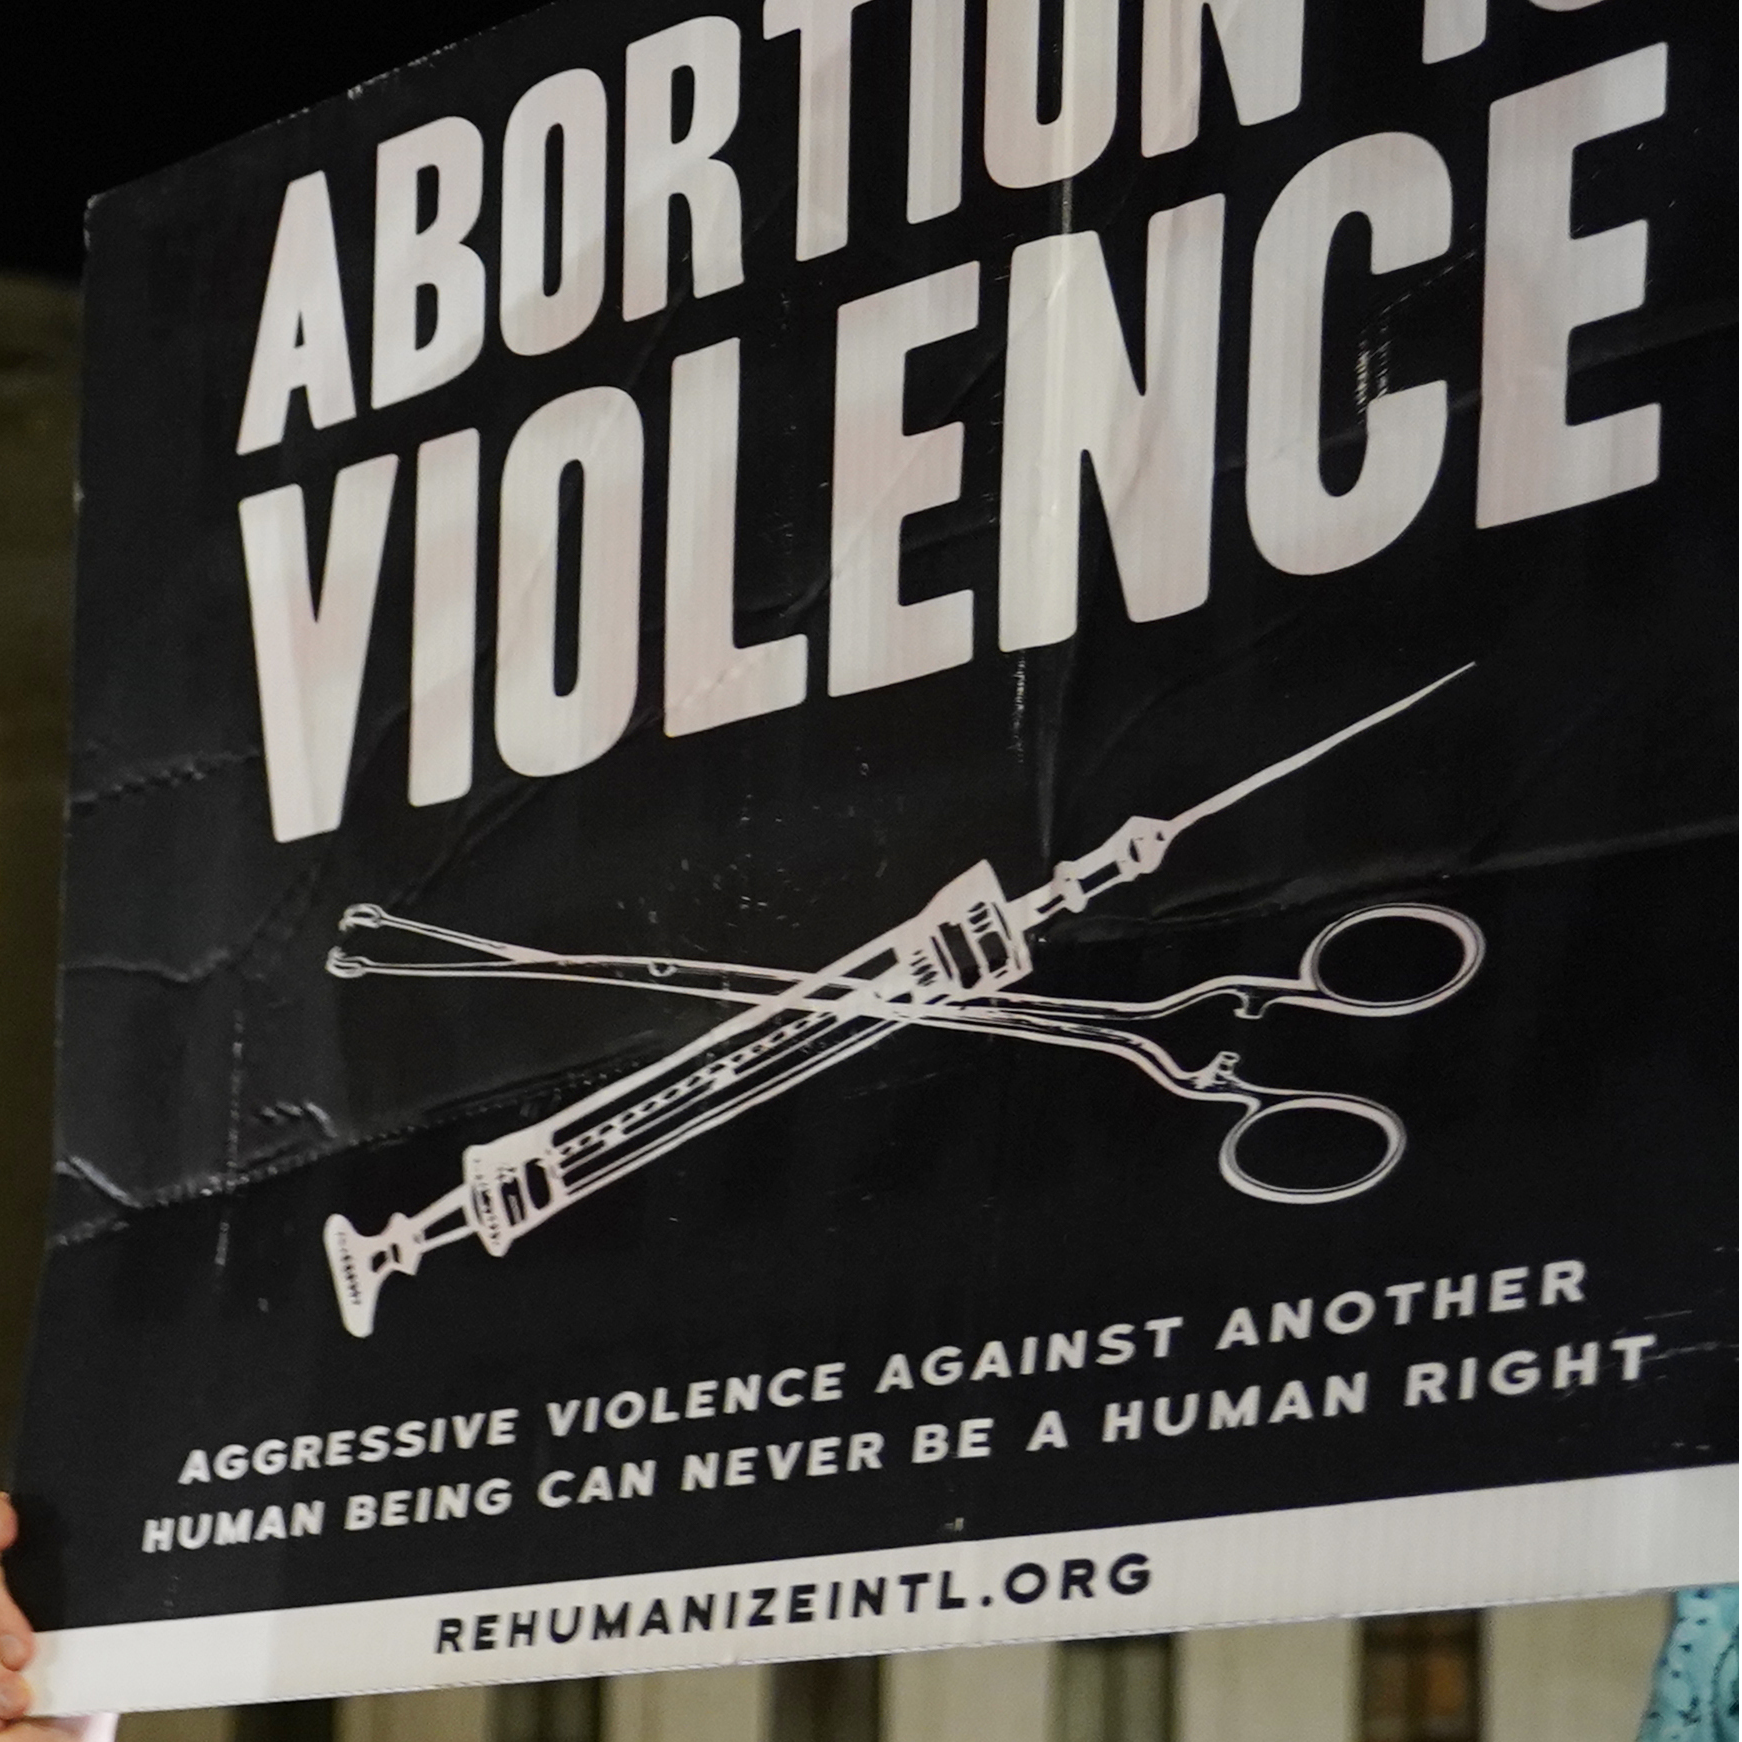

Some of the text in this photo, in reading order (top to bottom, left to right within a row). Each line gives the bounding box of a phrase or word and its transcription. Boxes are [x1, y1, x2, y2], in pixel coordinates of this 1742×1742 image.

[237, 41, 1670, 845] VIOLENCE
[141, 1333, 1657, 1553] HUMAN BEING CAN NEVER BE A HUMAN RIGHT
[178, 1259, 1587, 1485] AGGRESSIVE VIOLENCE AGAINST ANOTHER
[436, 1553, 1153, 1655] REHUMANIZEINTL.ORG
